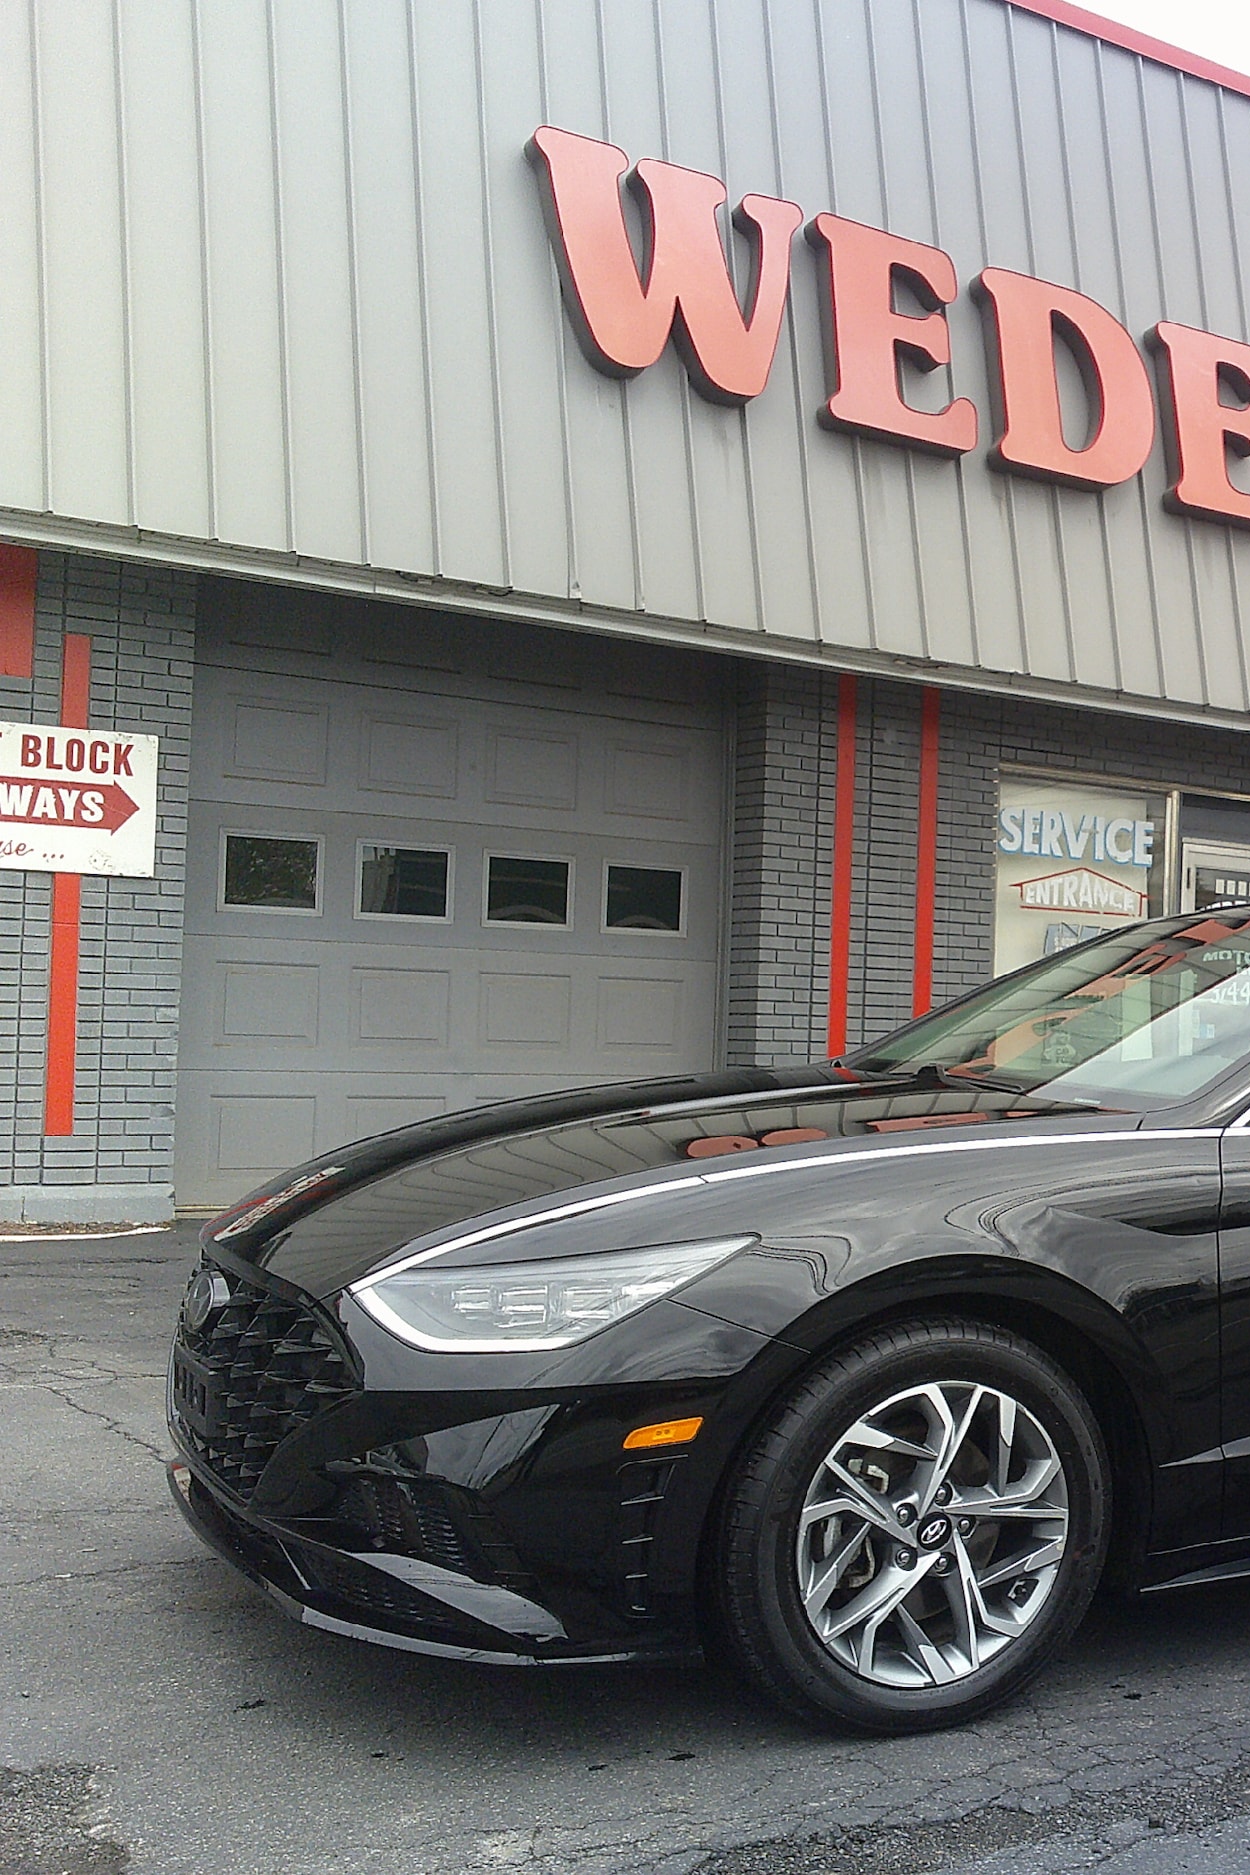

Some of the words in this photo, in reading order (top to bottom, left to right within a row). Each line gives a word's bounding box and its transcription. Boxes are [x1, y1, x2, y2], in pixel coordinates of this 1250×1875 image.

[21, 734, 134, 776] BLOCK
[998, 807, 1155, 867] SERVICE
[1025, 872, 1135, 912] ENTRANCE
